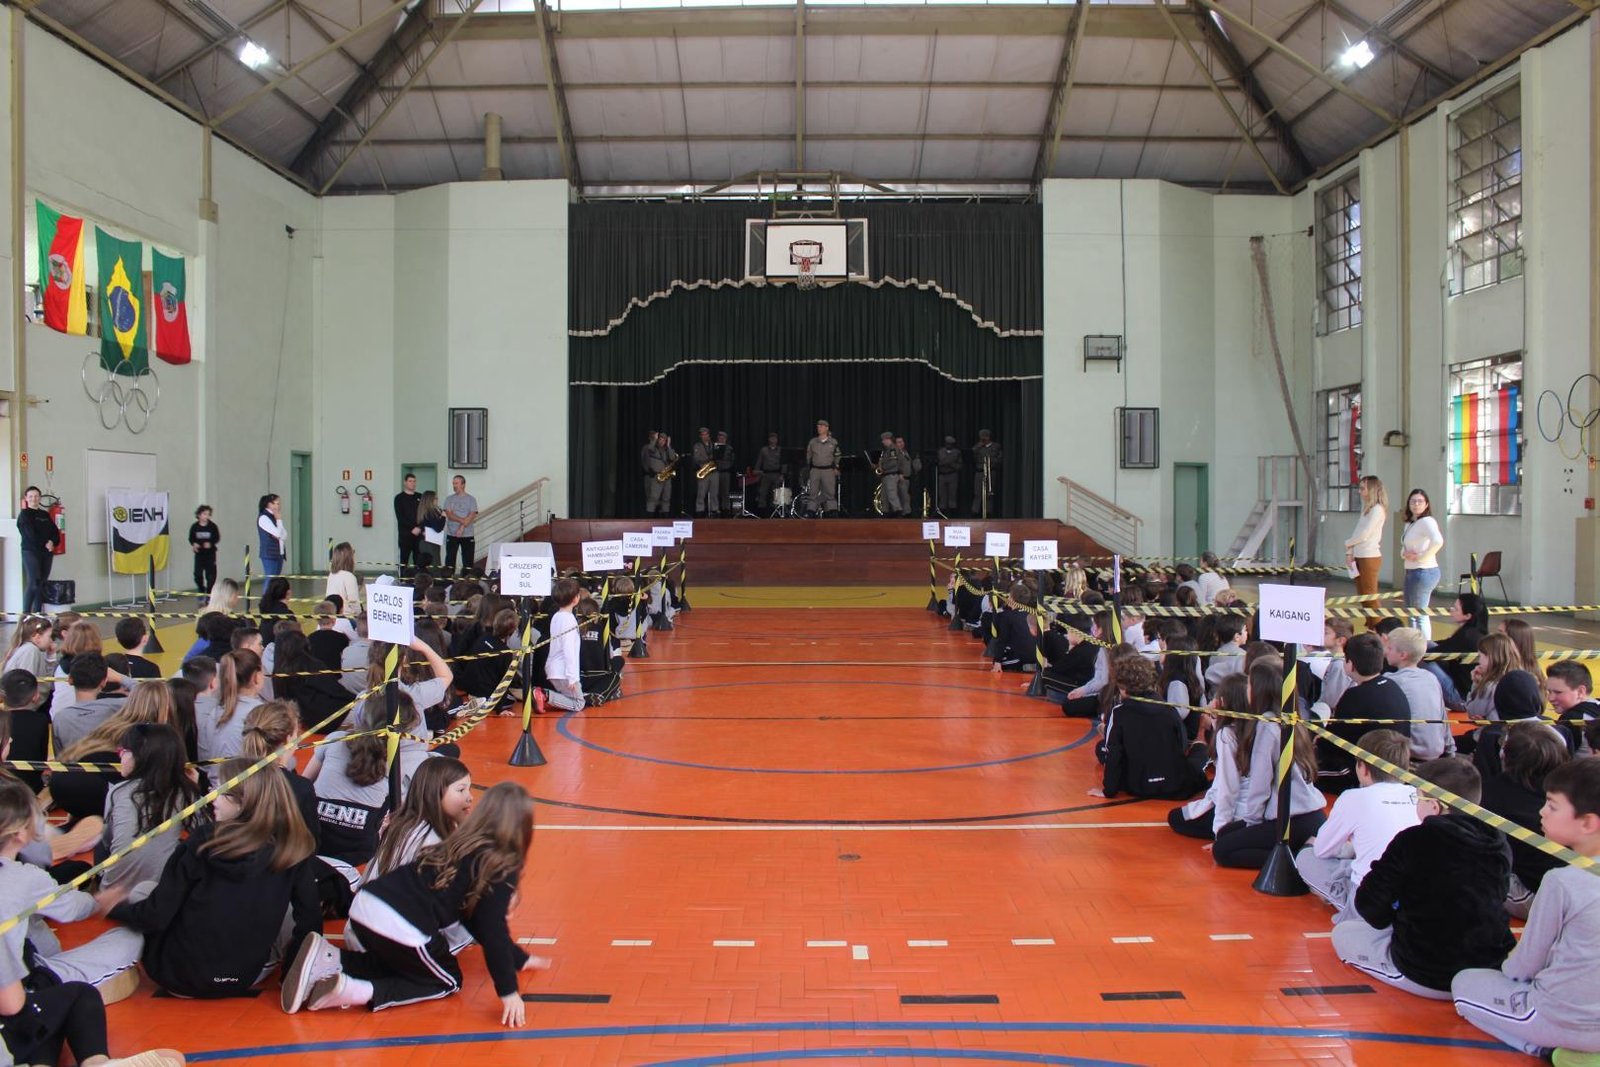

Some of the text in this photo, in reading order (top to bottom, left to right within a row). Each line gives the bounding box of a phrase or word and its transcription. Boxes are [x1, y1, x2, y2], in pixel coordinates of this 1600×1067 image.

[128, 507, 164, 522] IENH
[508, 562, 543, 570] CRUZEIRO
[373, 592, 403, 608] CARLOS
[372, 609, 403, 624] BERNER
[1269, 608, 1311, 622] KAIGANG
[317, 800, 369, 826] IENH
